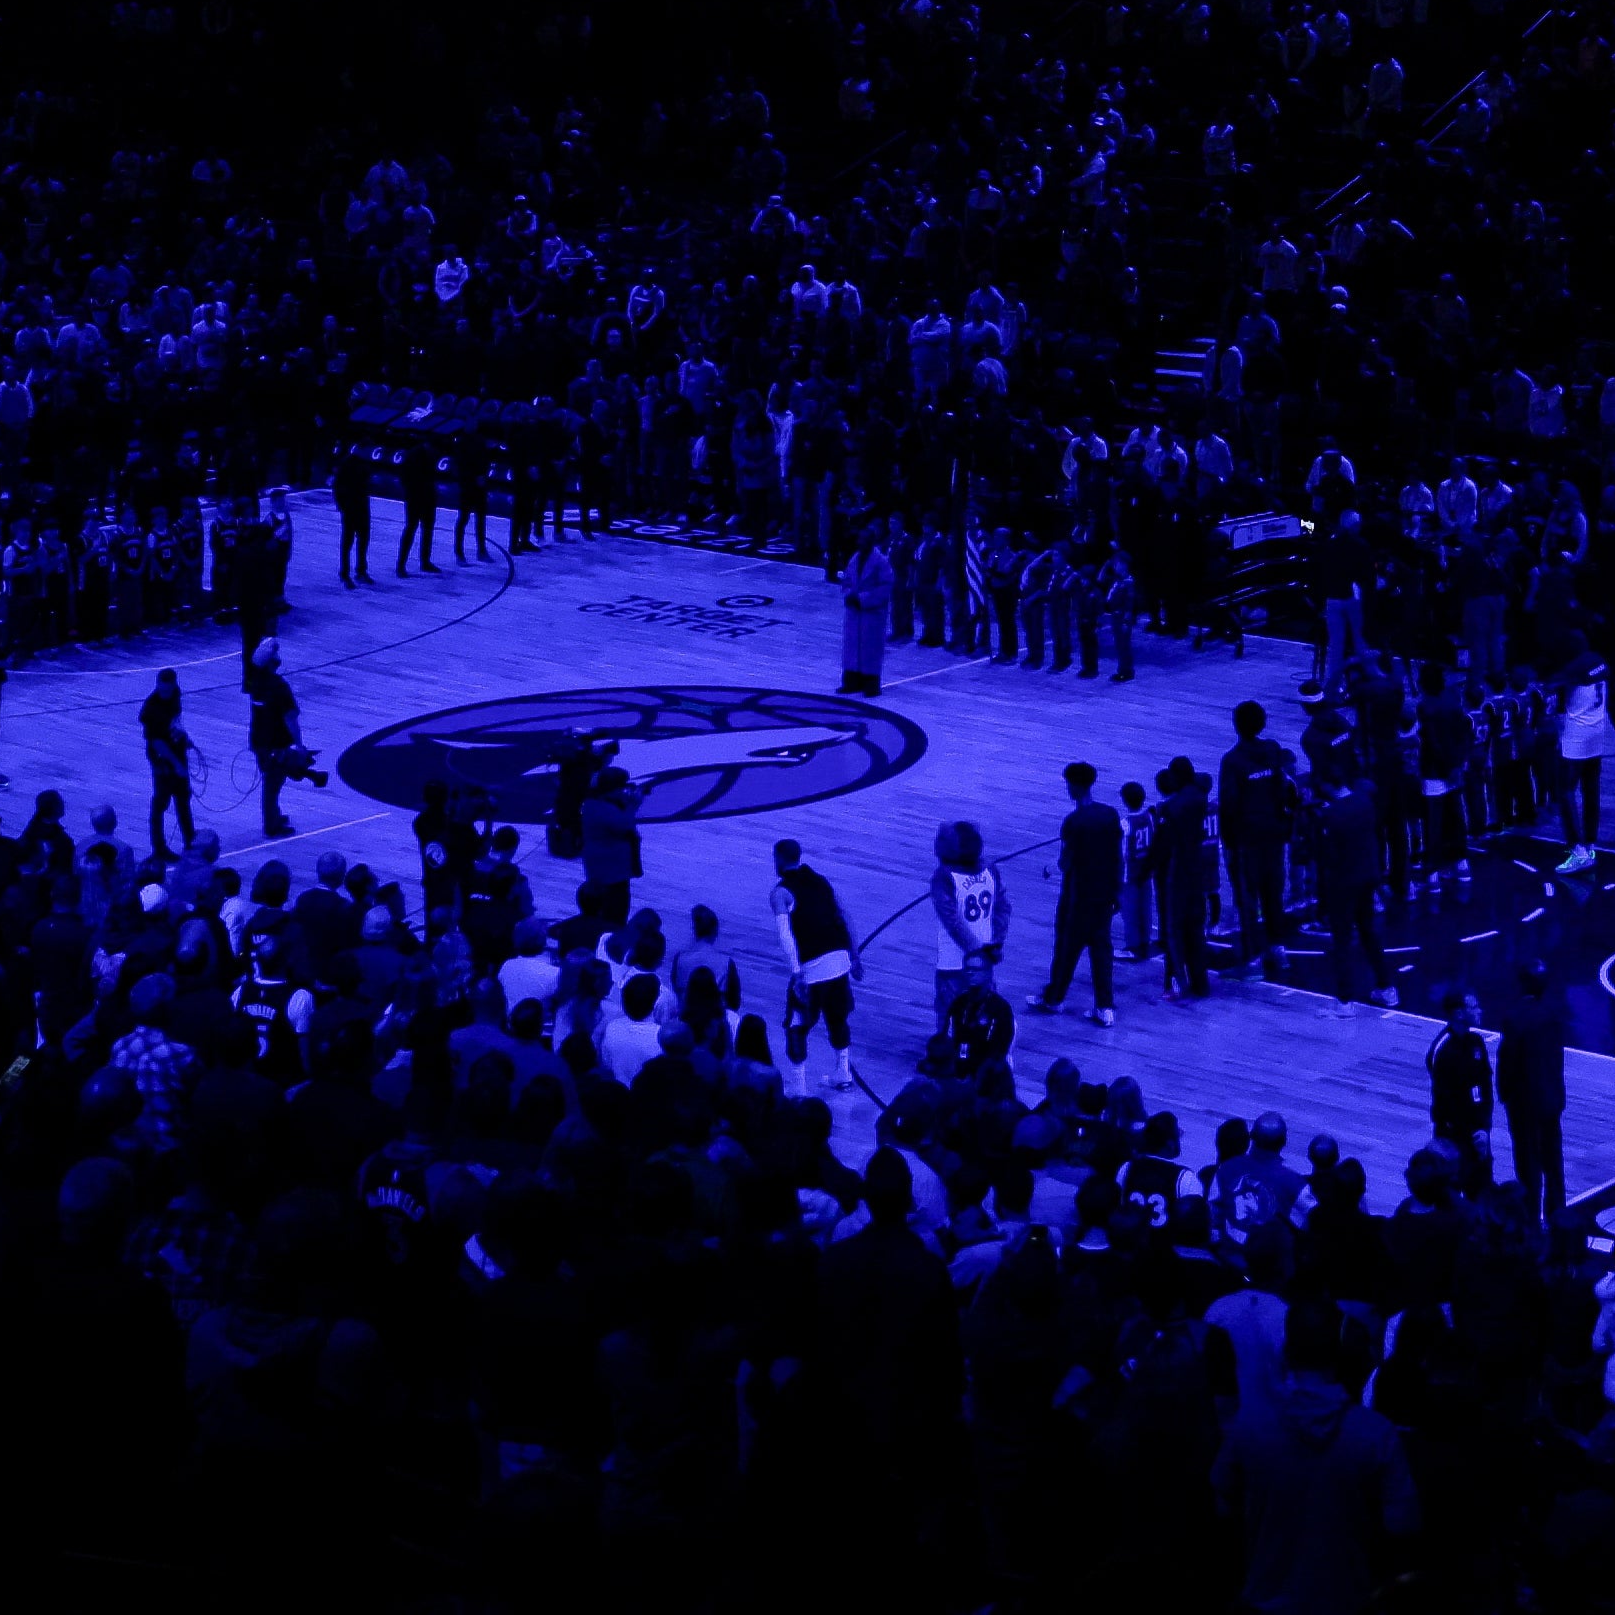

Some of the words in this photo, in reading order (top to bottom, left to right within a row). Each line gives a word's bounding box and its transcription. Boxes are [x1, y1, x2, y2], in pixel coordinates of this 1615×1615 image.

[577, 603, 757, 638] CENTER
[615, 594, 795, 628] TARGET
[963, 890, 992, 922] 89
